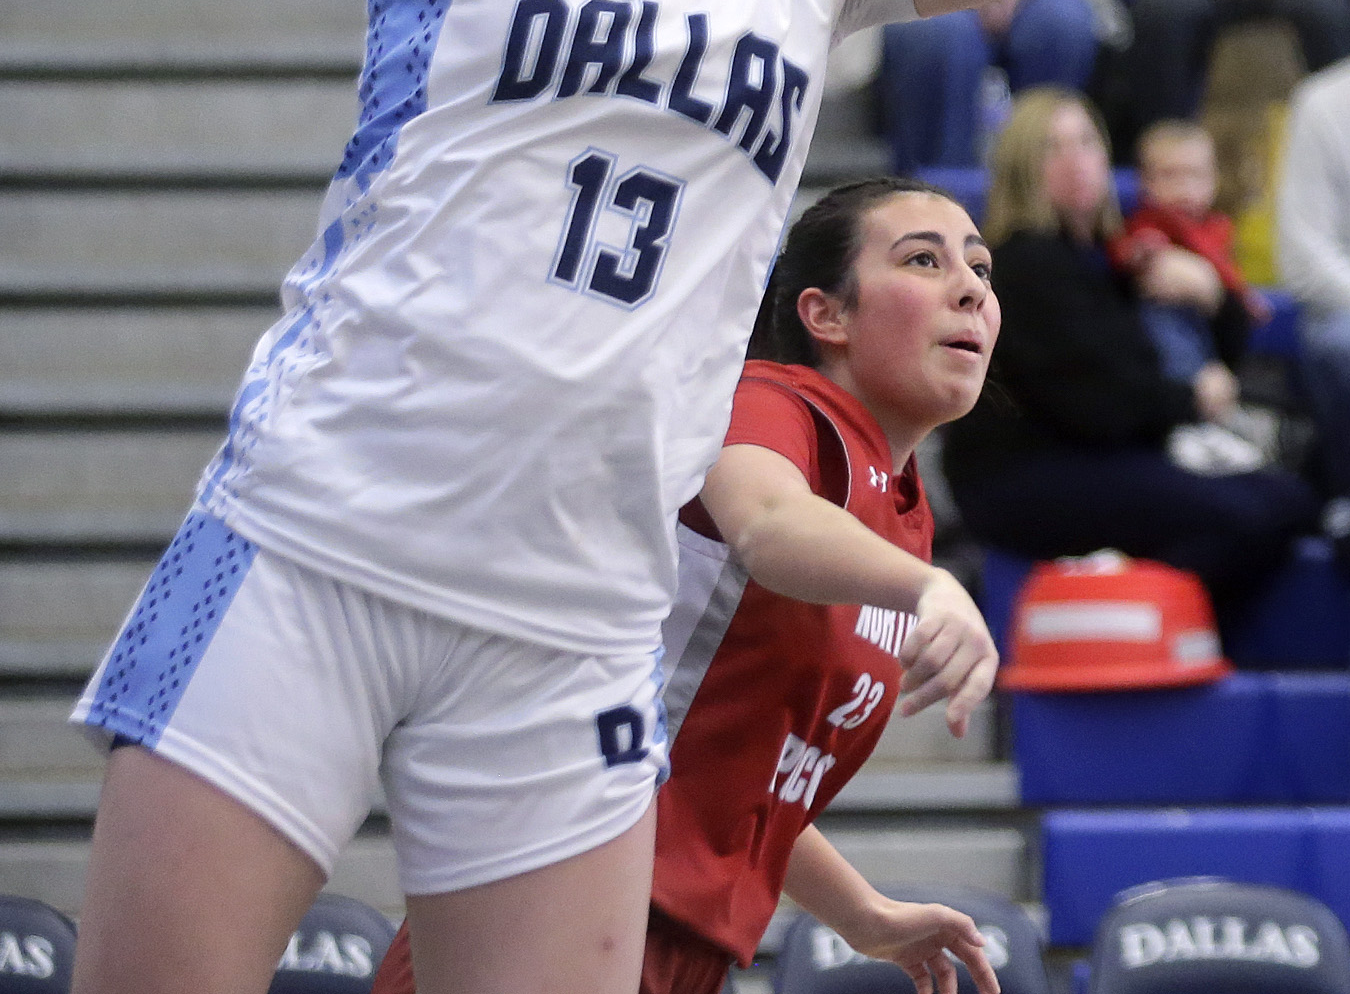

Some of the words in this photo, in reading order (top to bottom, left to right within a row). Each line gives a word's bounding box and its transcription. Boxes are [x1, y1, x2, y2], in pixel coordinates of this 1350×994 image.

[544, 145, 688, 312] 13
[826, 672, 886, 730] 23
[1118, 915, 1321, 970] DALLAS
